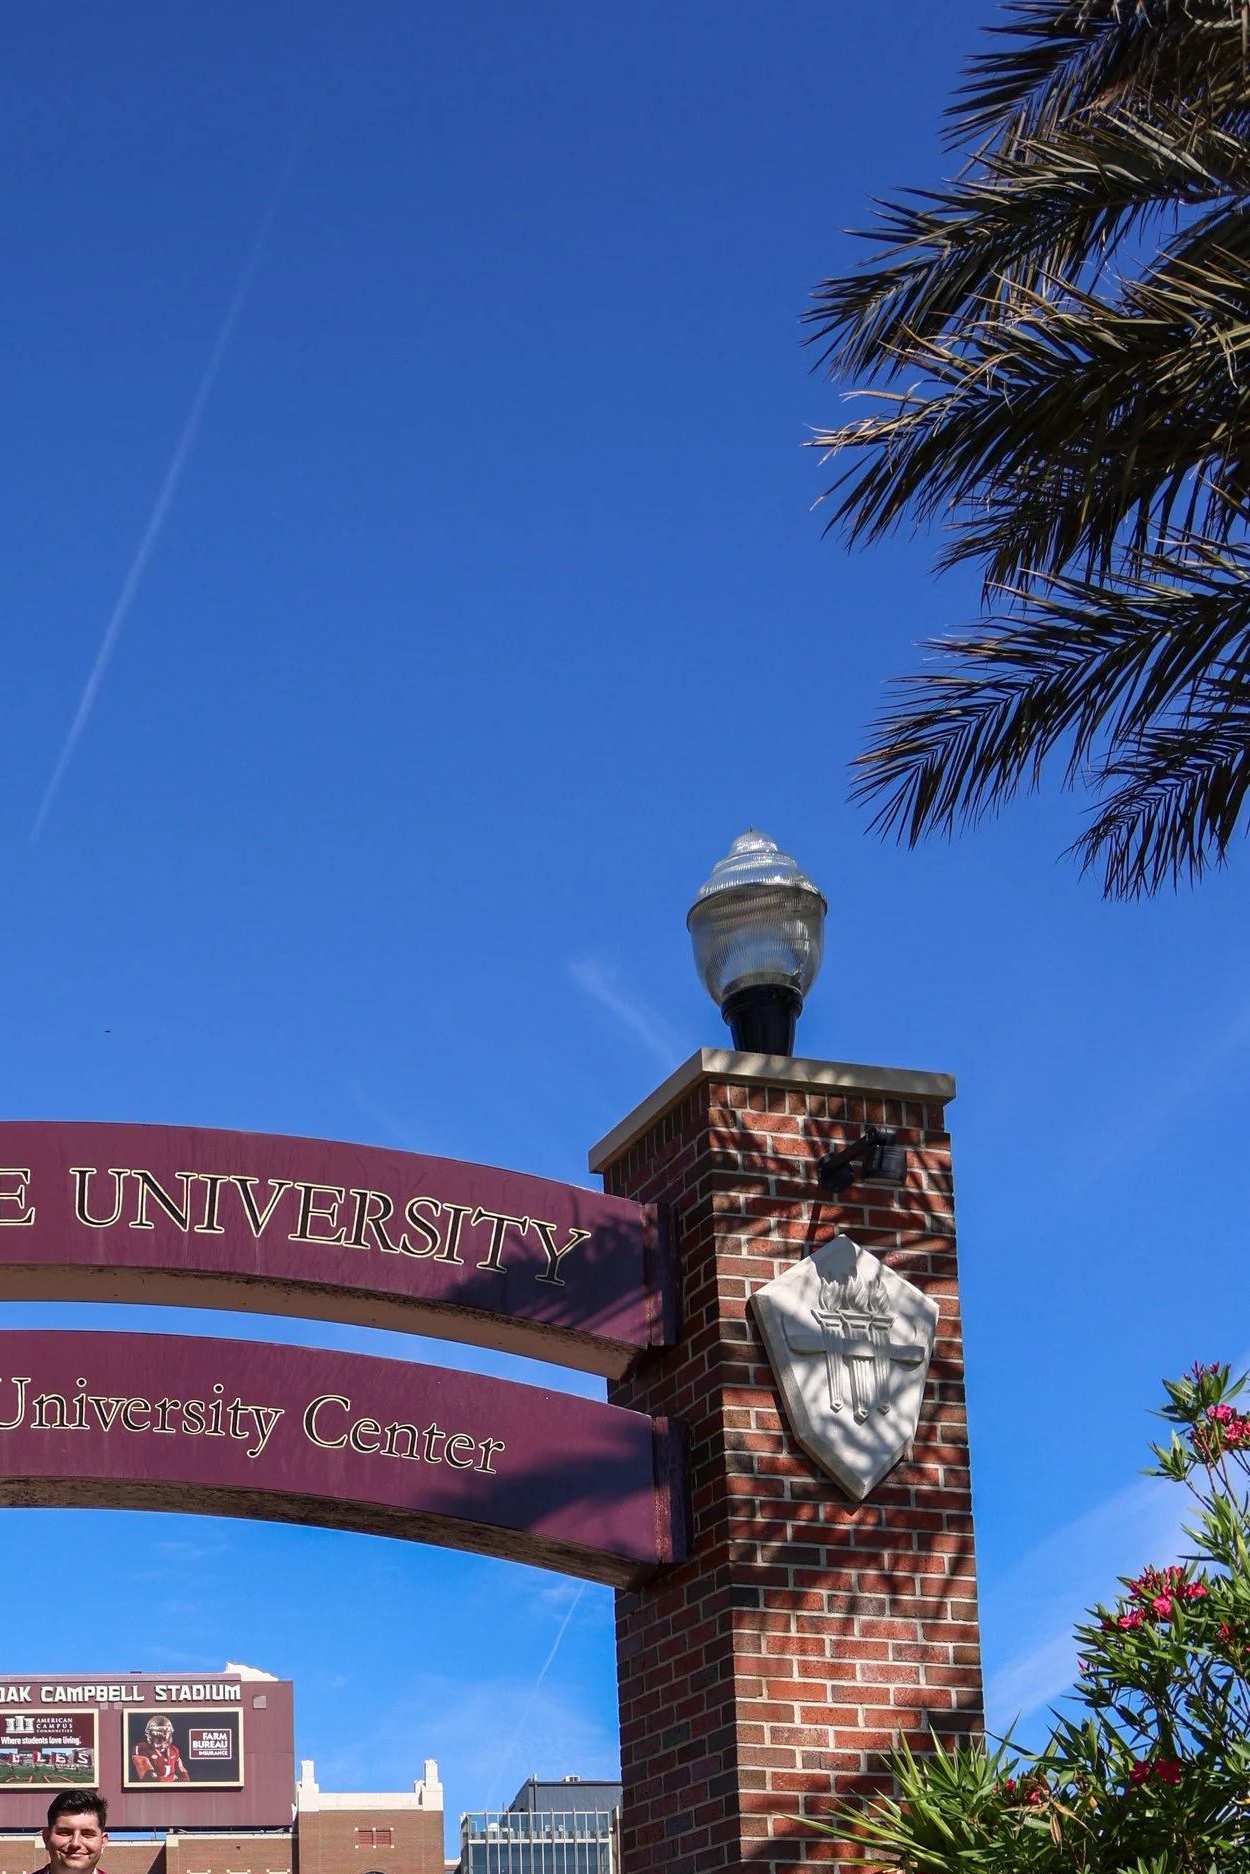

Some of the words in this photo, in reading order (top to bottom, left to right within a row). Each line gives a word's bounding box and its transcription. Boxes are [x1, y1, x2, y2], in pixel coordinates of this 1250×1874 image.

[69, 1167, 592, 1287] UNIVERSITY
[303, 1395, 506, 1475] Center
[40, 1685, 145, 1703] CAMPBELL
[154, 1684, 242, 1702] STADIUM
[1, 1736, 22, 1745] Where
[22, 1736, 48, 1745] students
[49, 1736, 62, 1745] love
[202, 1732, 227, 1740] FARM
[192, 1740, 228, 1749] BUREAU
